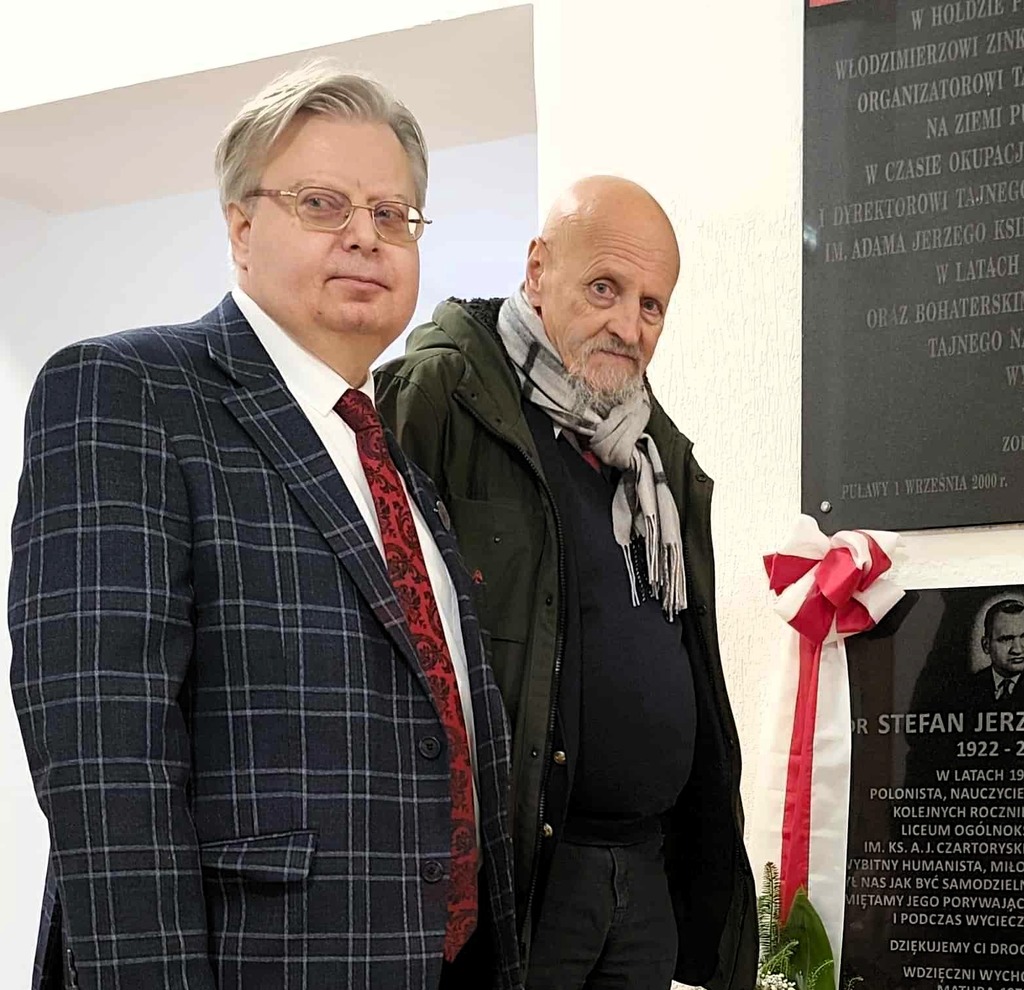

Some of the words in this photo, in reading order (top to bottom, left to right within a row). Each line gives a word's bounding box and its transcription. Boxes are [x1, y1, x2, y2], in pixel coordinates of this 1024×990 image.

[911, 8, 924, 31] W
[835, 35, 979, 81] WŁODZIMIERZOWI
[857, 69, 1004, 113] ORGANIZATOROWI
[925, 115, 948, 139] NA
[955, 106, 1002, 135] ZIEMI
[865, 163, 878, 185] W
[885, 153, 942, 182] CZASIE
[833, 190, 949, 227] DYREKTOROWI
[851, 232, 906, 260] ADAMA
[912, 222, 987, 252] JERZEGO
[936, 262, 949, 285] W
[955, 254, 1020, 283] LATACH
[928, 330, 1003, 358] TAJNEGO
[971, 472, 998, 490] 2000
[878, 712, 964, 734] STEFAN
[956, 741, 999, 757] 1922
[936, 769, 950, 782] W
[954, 769, 1004, 782] LATACH
[870, 788, 947, 801] POLONISTA,
[893, 806, 966, 818] KOLEJNYCH
[901, 824, 951, 836] LICEUM
[864, 841, 885, 853] IM.
[888, 841, 908, 853] KS.
[902, 859, 987, 874] HUMANISTA,
[861, 877, 887, 889] NAS
[888, 877, 912, 889] JAK
[915, 874, 940, 889] BYĆ
[906, 896, 940, 908] JEGO
[900, 912, 962, 925] PODCZAS
[890, 940, 971, 955] DZIĘKUJEMY
[973, 942, 986, 954] CI
[903, 966, 976, 983] WDZIĘCZNI
